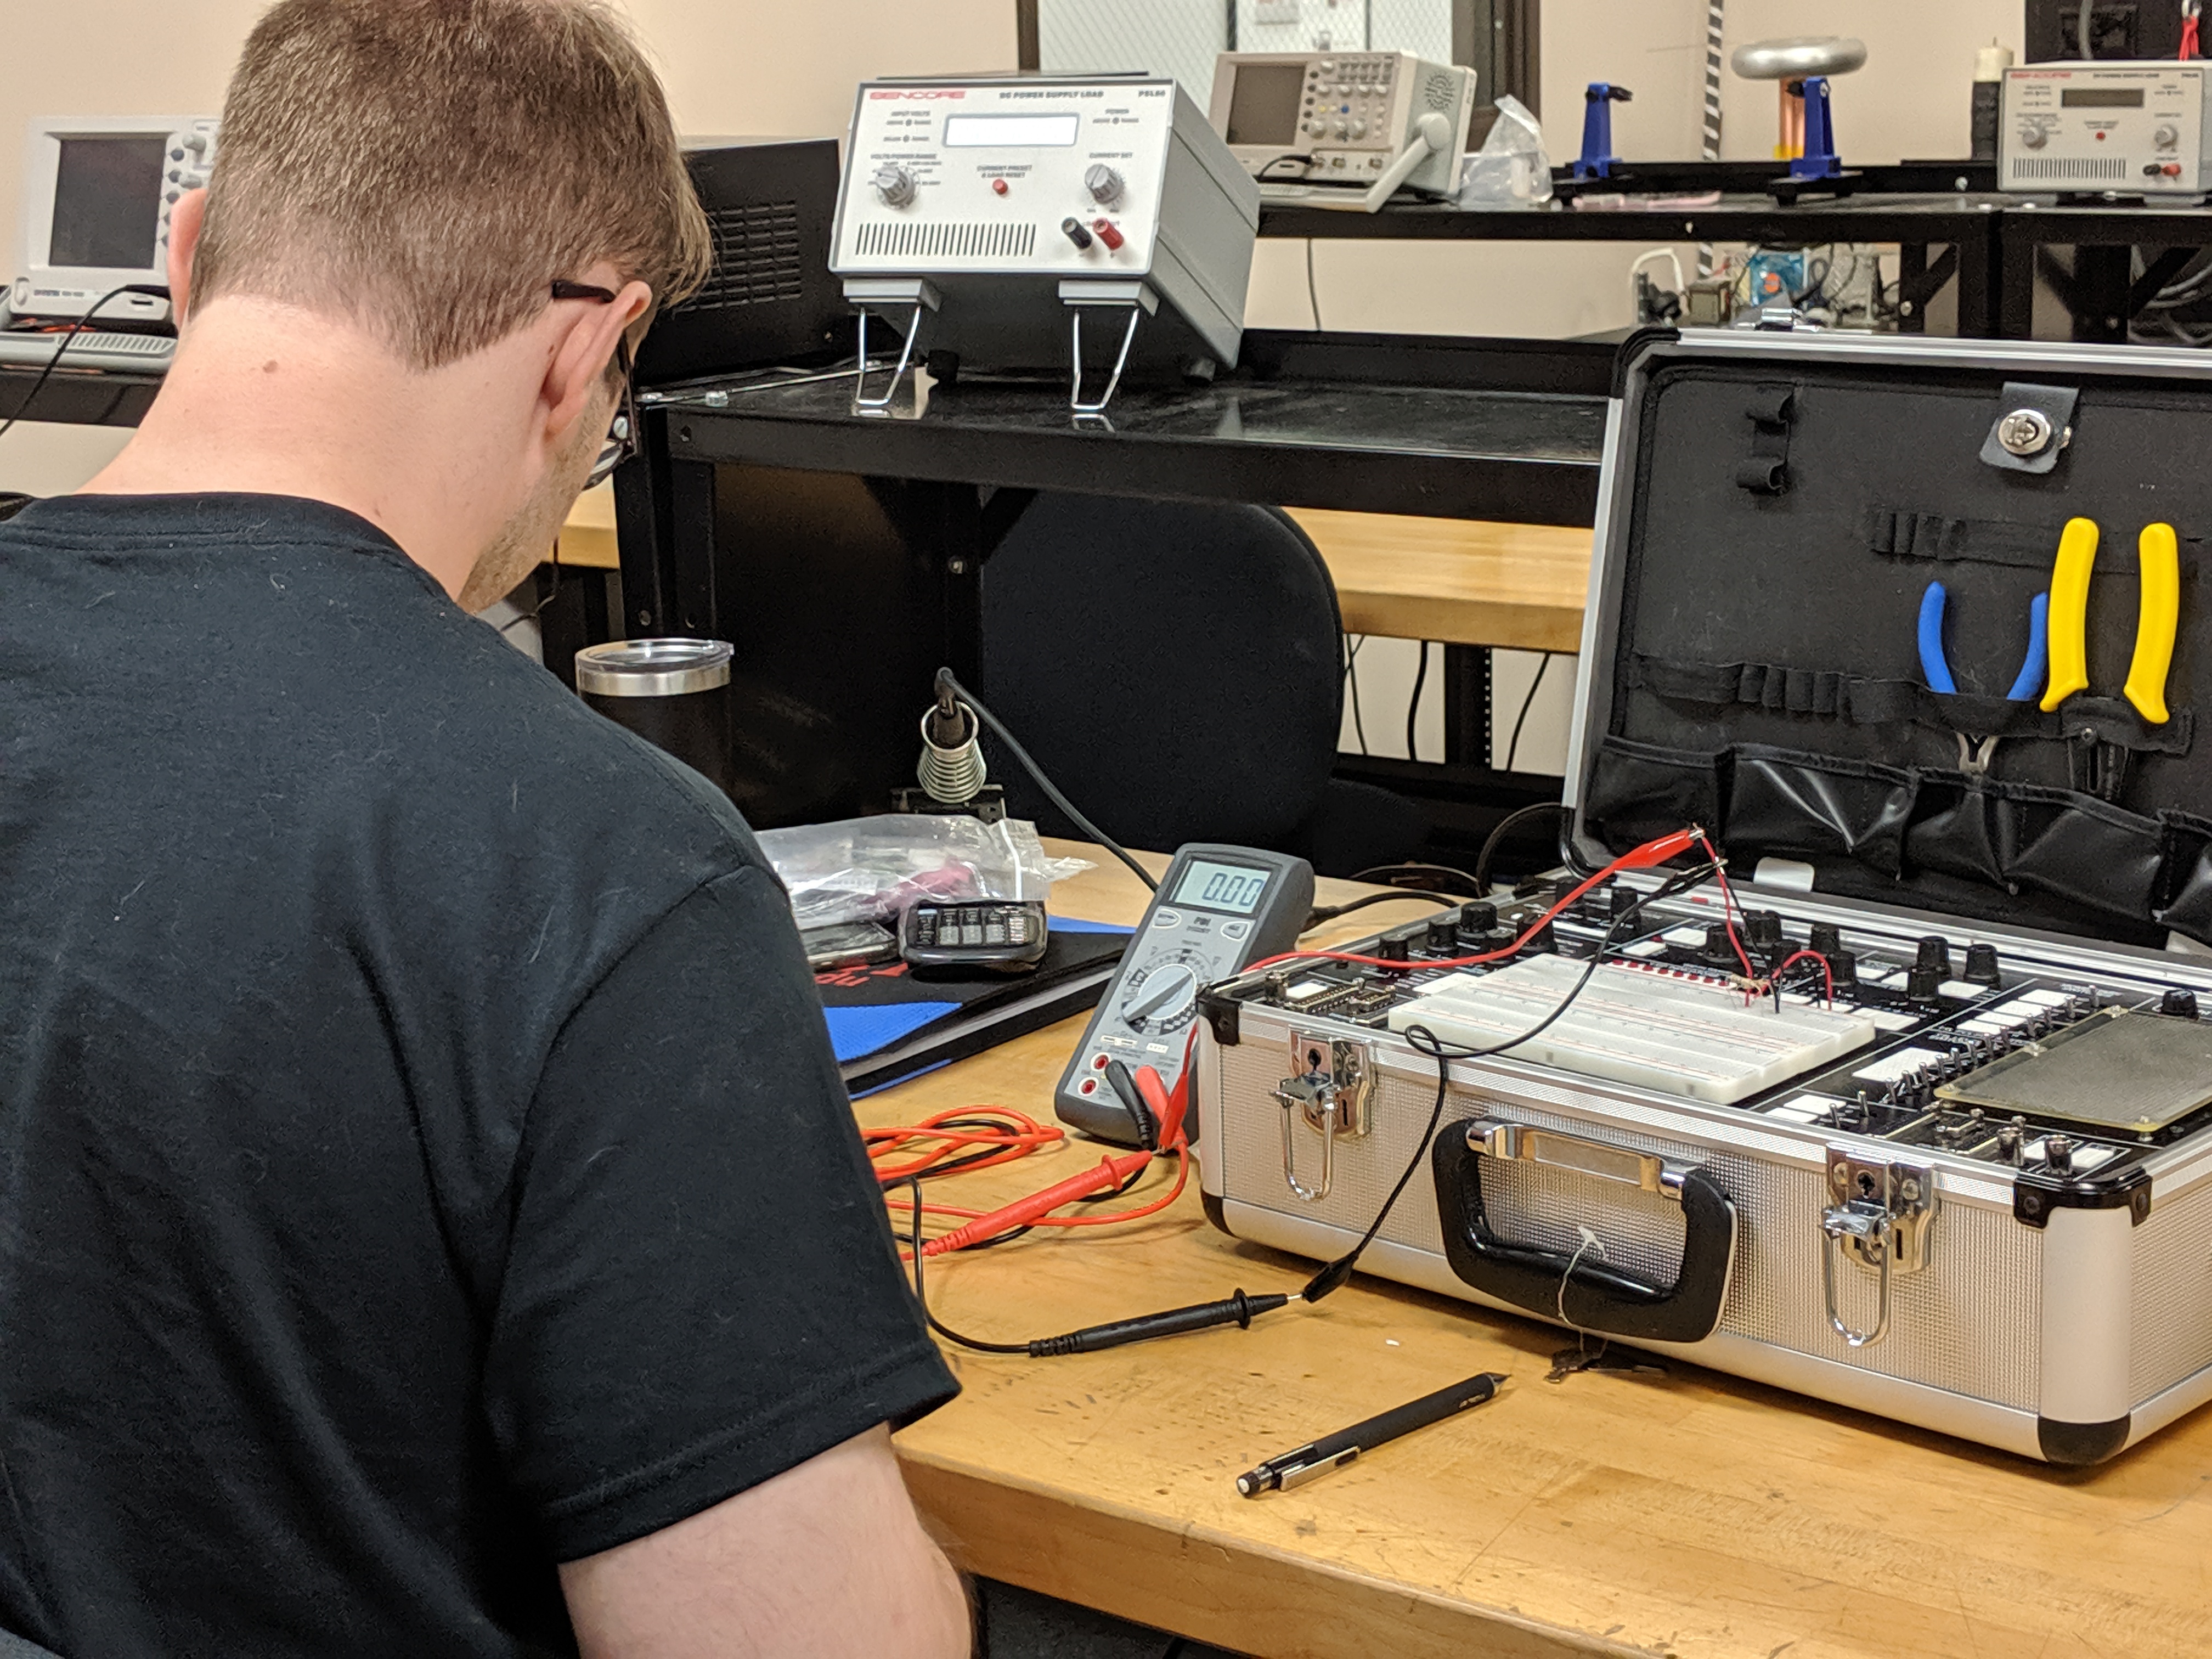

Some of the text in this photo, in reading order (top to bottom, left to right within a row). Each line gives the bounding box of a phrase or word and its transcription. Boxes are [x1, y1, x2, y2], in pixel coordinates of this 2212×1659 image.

[1046, 91, 1079, 99] SUPPLY
[1080, 90, 1104, 98] LOAD
[1201, 872, 1265, 906] 0.00
